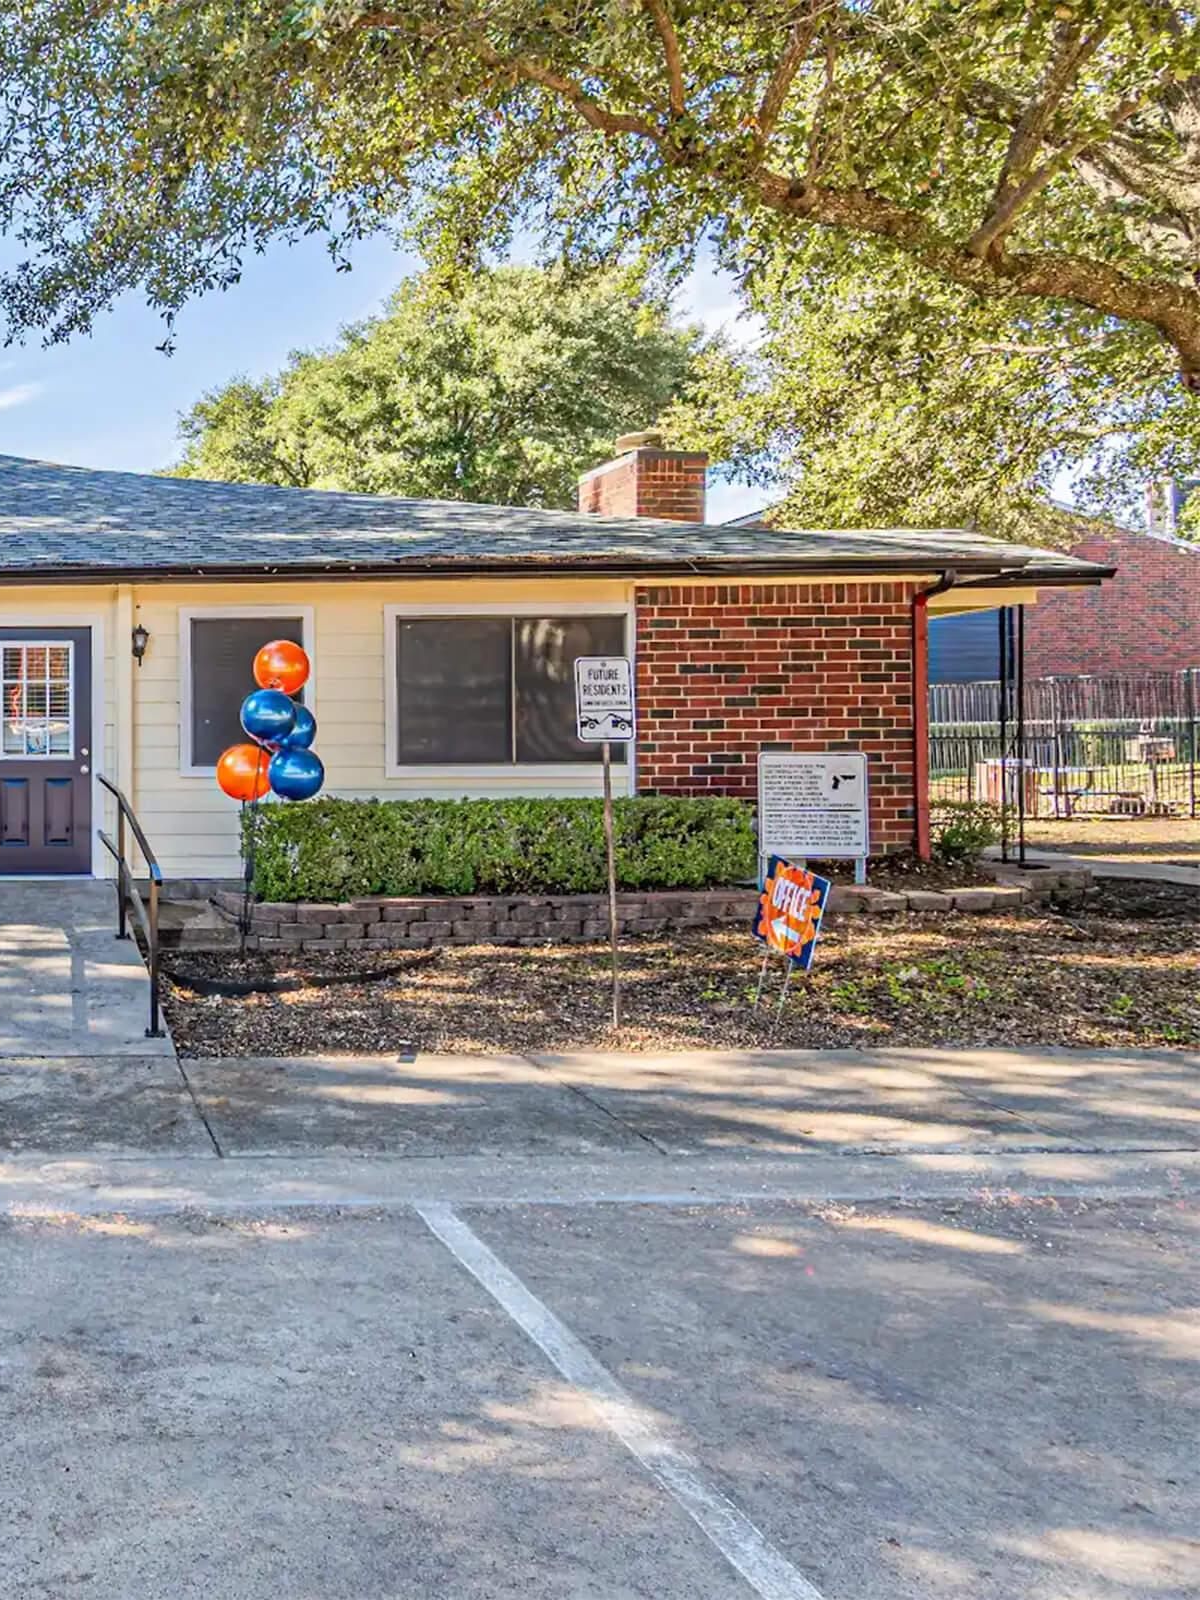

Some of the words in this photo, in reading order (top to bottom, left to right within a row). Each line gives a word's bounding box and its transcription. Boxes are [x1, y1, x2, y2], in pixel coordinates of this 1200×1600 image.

[588, 669, 619, 680] FUTURE
[583, 684, 627, 696] RESIDENTS
[772, 877, 811, 922] OFFICE
